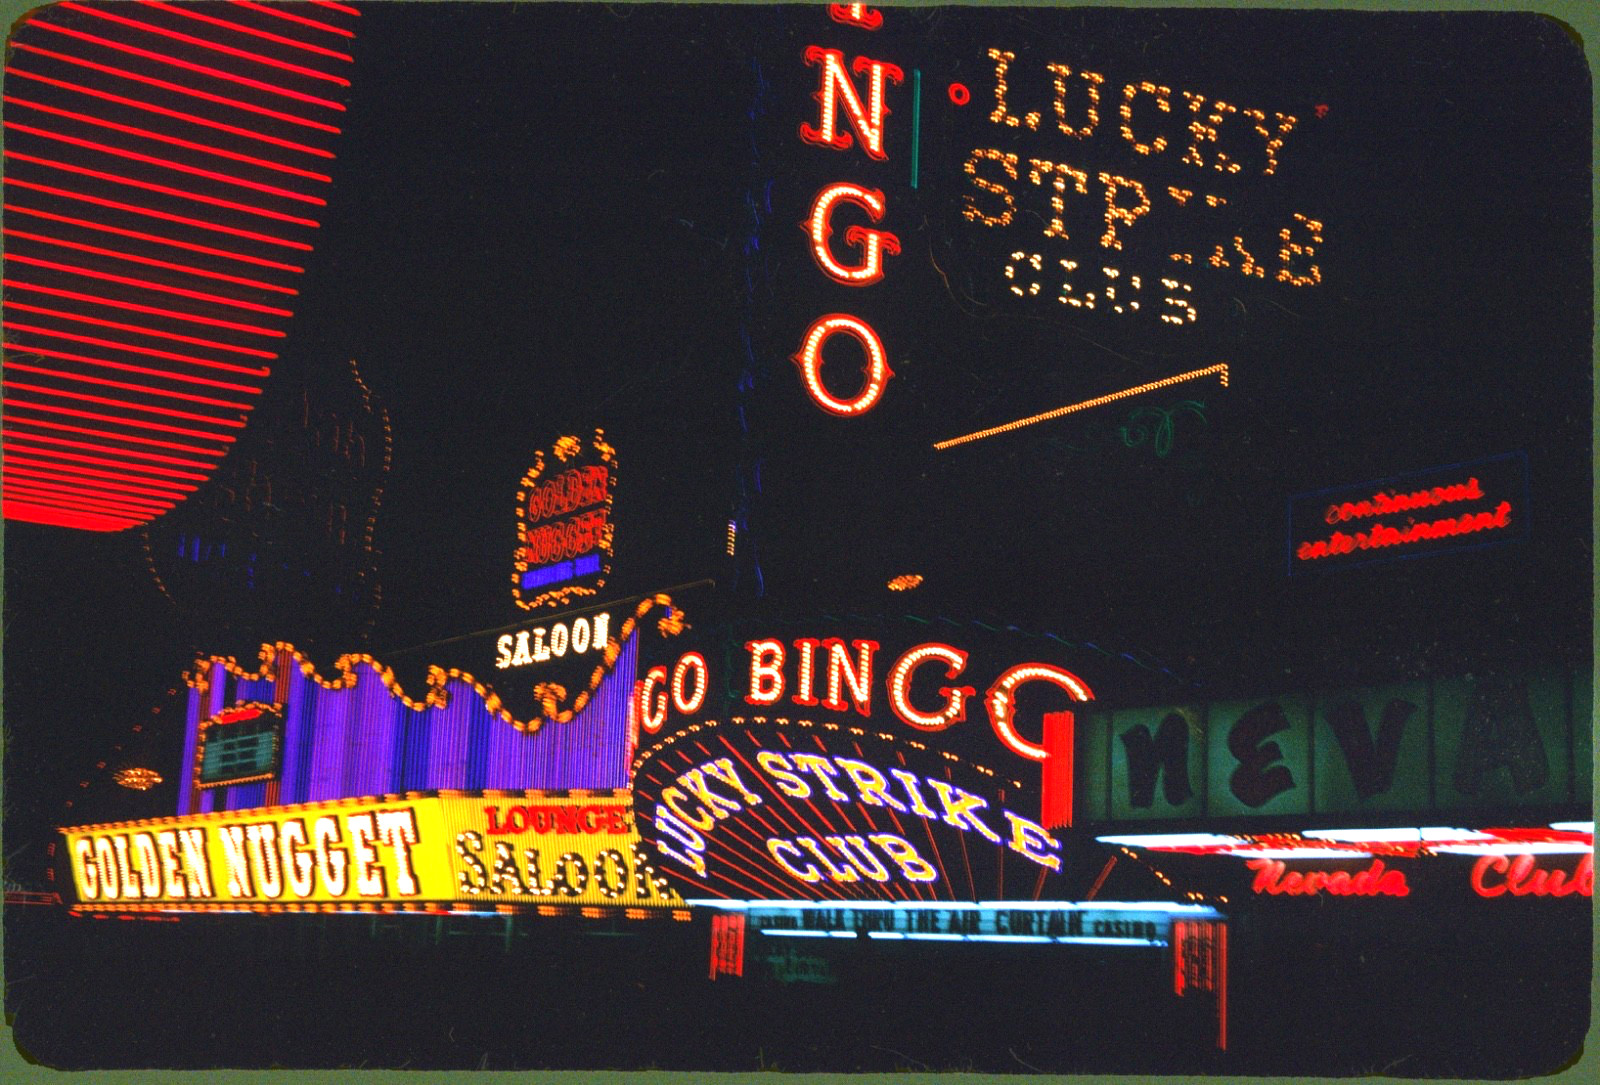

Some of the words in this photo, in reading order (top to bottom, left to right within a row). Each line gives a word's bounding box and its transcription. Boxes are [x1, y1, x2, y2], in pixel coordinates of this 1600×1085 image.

[987, 47, 1297, 175] LUCKY
[1297, 501, 1512, 560] entertainment
[495, 612, 610, 669] SALOON
[483, 804, 629, 836] LOUNGE
[653, 756, 763, 879] LUCKY
[755, 750, 1063, 873] STRIKE
[75, 828, 217, 900] GOLDEN
[218, 806, 422, 899] NUGGET
[765, 831, 938, 884] CLUB
[1245, 857, 1410, 897] Nevada
[903, 909, 940, 933] THE
